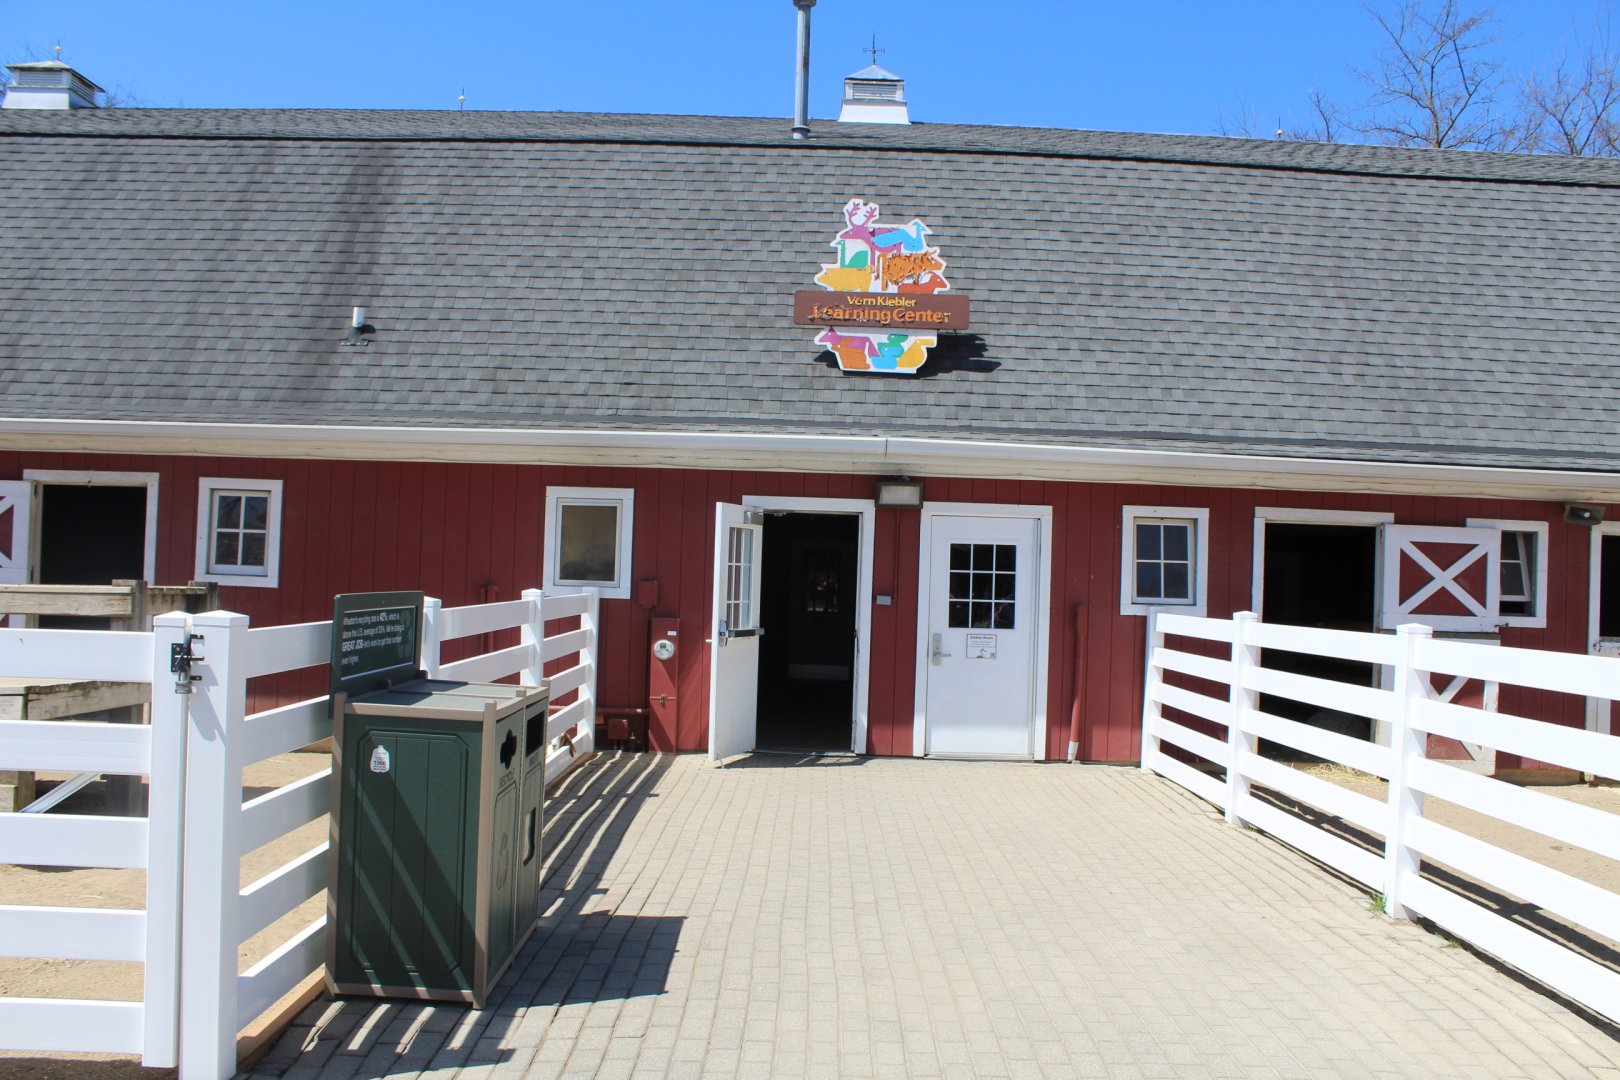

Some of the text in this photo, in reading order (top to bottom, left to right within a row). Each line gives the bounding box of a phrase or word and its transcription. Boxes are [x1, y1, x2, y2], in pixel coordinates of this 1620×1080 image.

[847, 296, 917, 308] Vern Kiebler
[812, 304, 951, 324] Learning Center
[342, 640, 355, 652] GREAT
